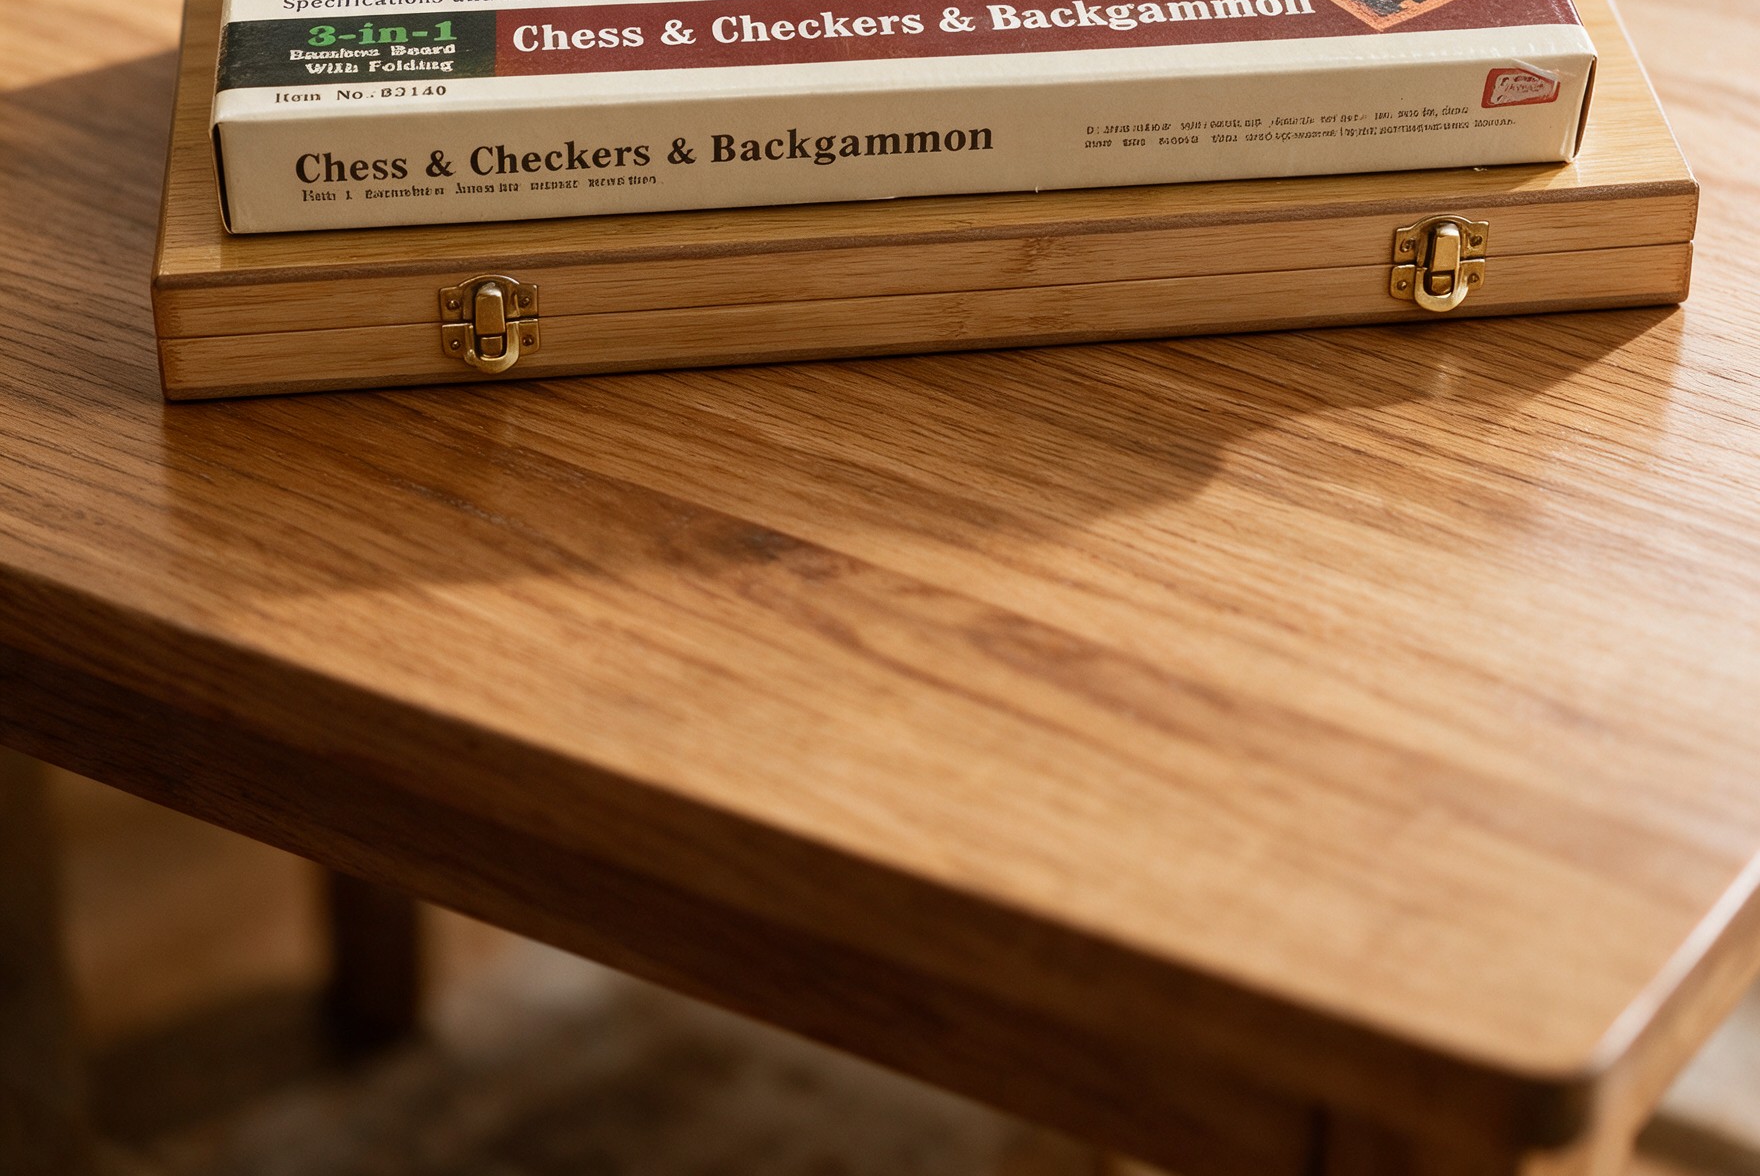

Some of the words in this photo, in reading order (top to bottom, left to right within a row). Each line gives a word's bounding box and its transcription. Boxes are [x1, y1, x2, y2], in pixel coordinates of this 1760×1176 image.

[307, 21, 458, 47] 3-in-1
[512, 24, 645, 52] Chess
[660, 19, 697, 46] &
[711, 11, 925, 43] Checkers
[938, 6, 976, 33] &
[295, 152, 409, 184] Chess
[425, 149, 457, 178] &
[469, 140, 652, 176] Checkers
[666, 136, 698, 165] &
[710, 127, 995, 166] Backgammon
